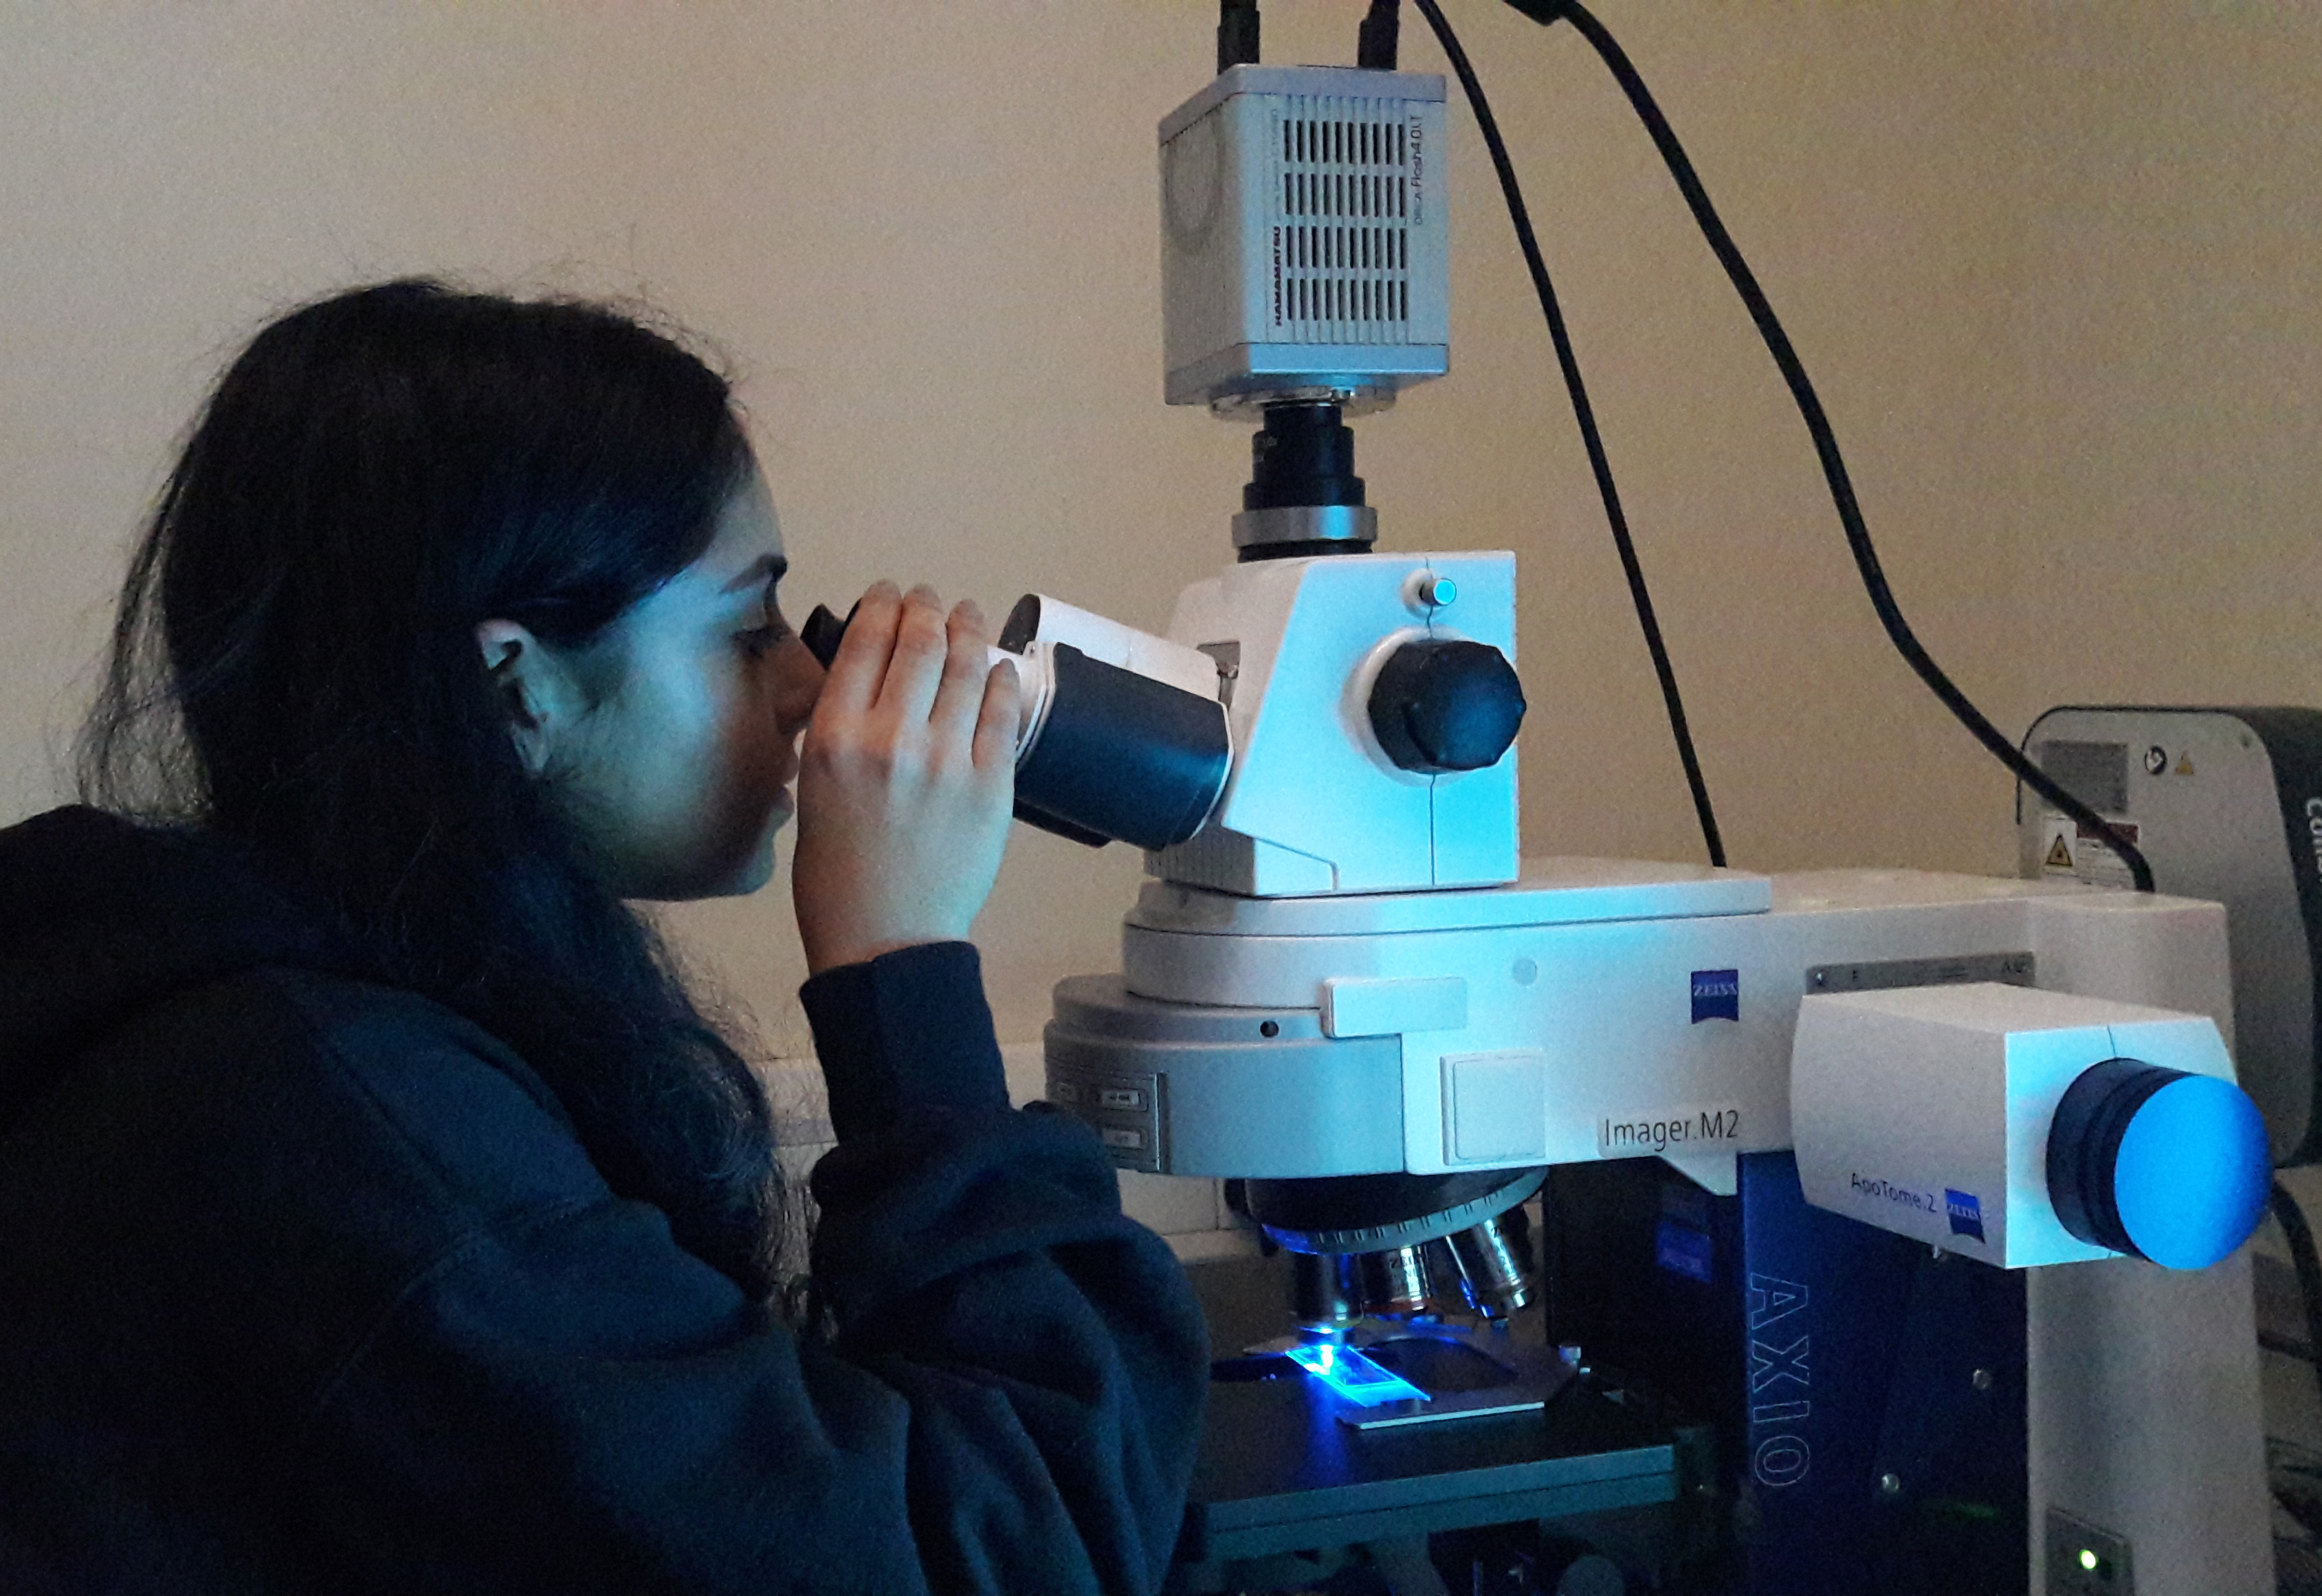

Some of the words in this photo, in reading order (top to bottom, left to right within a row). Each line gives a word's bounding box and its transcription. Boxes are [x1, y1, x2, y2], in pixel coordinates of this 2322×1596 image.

[1273, 226, 1283, 326] HAMAMATSU
[1693, 983, 1737, 996] ZEISS
[1606, 1109, 1739, 1152] Imager.M2
[1851, 1172, 1937, 1212] ApoTome.2
[1750, 1272, 1810, 1487] AXIO
